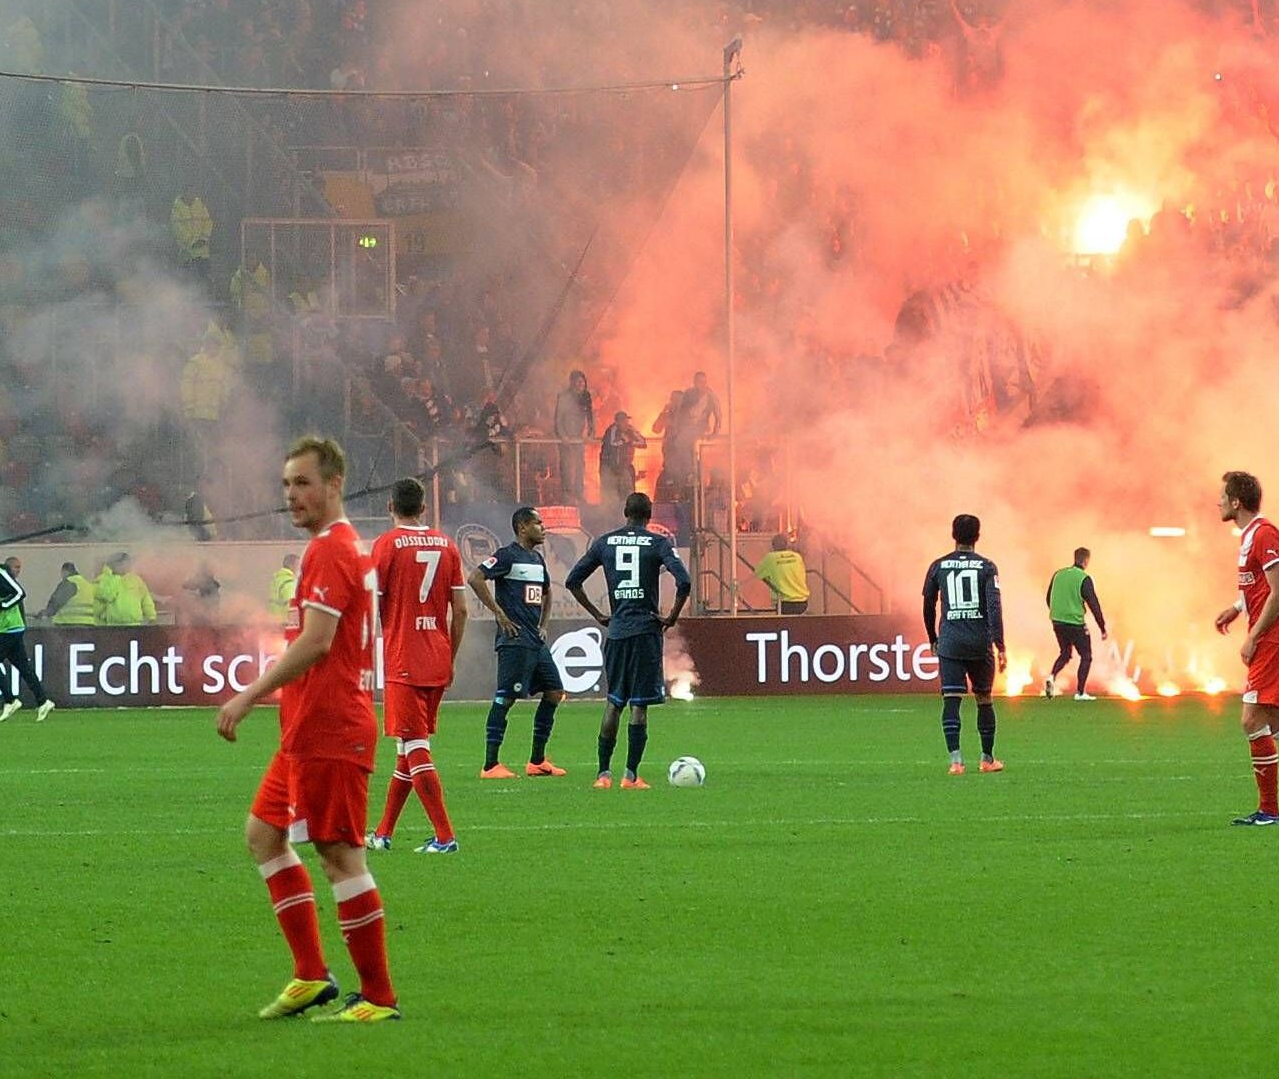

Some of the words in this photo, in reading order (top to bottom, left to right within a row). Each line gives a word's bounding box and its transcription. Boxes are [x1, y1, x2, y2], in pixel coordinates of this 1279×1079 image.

[415, 550, 441, 603] 7
[615, 545, 640, 589] 9
[946, 569, 980, 609] 10
[69, 639, 184, 695] Echt
[746, 631, 940, 686] Thorste
